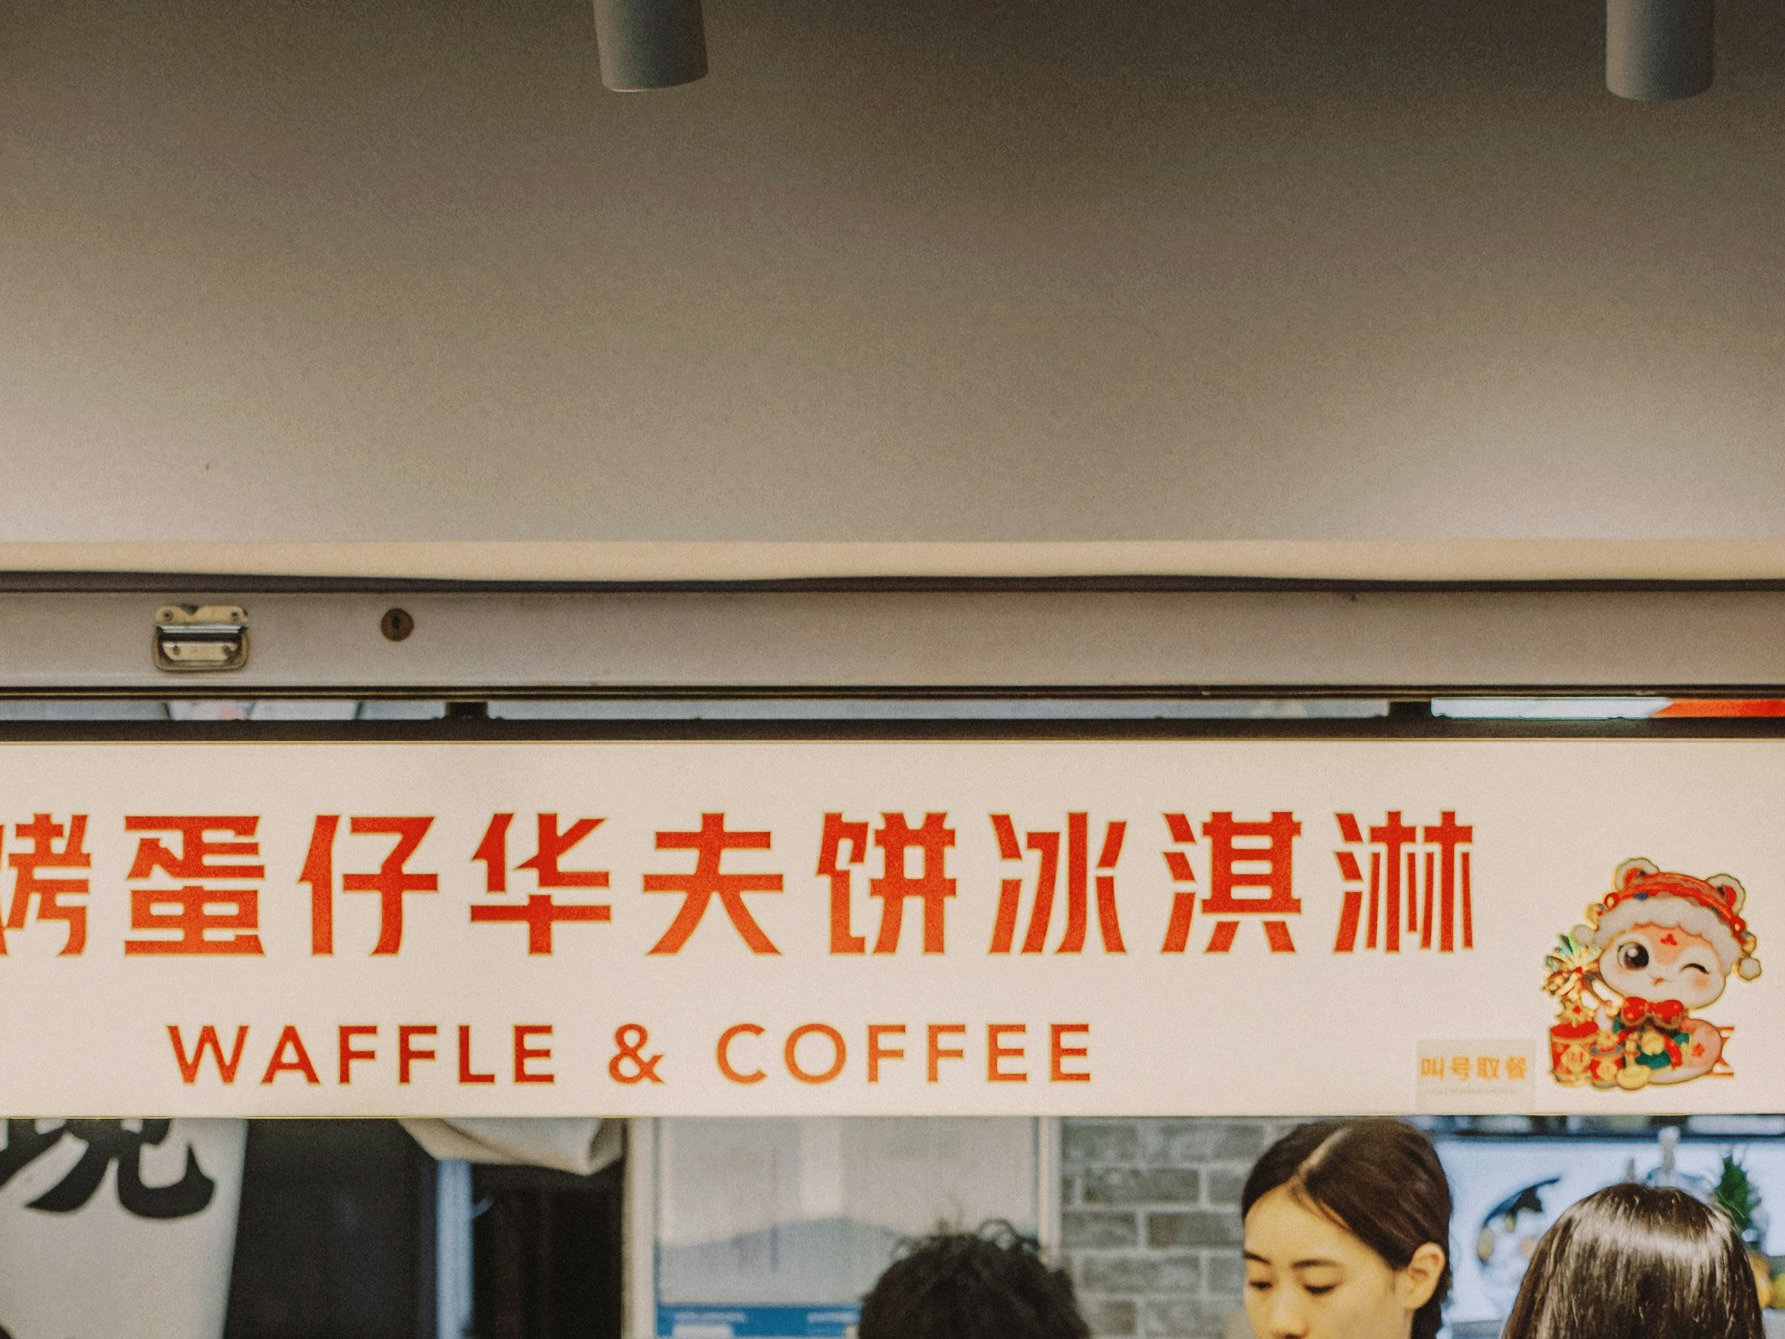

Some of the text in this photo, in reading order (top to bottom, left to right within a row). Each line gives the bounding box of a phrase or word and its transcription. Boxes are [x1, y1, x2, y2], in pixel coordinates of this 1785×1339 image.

[165, 1022, 1095, 1087] WAFFLE & COFFEE
[1420, 1056, 1527, 1081] 叫号取餐
